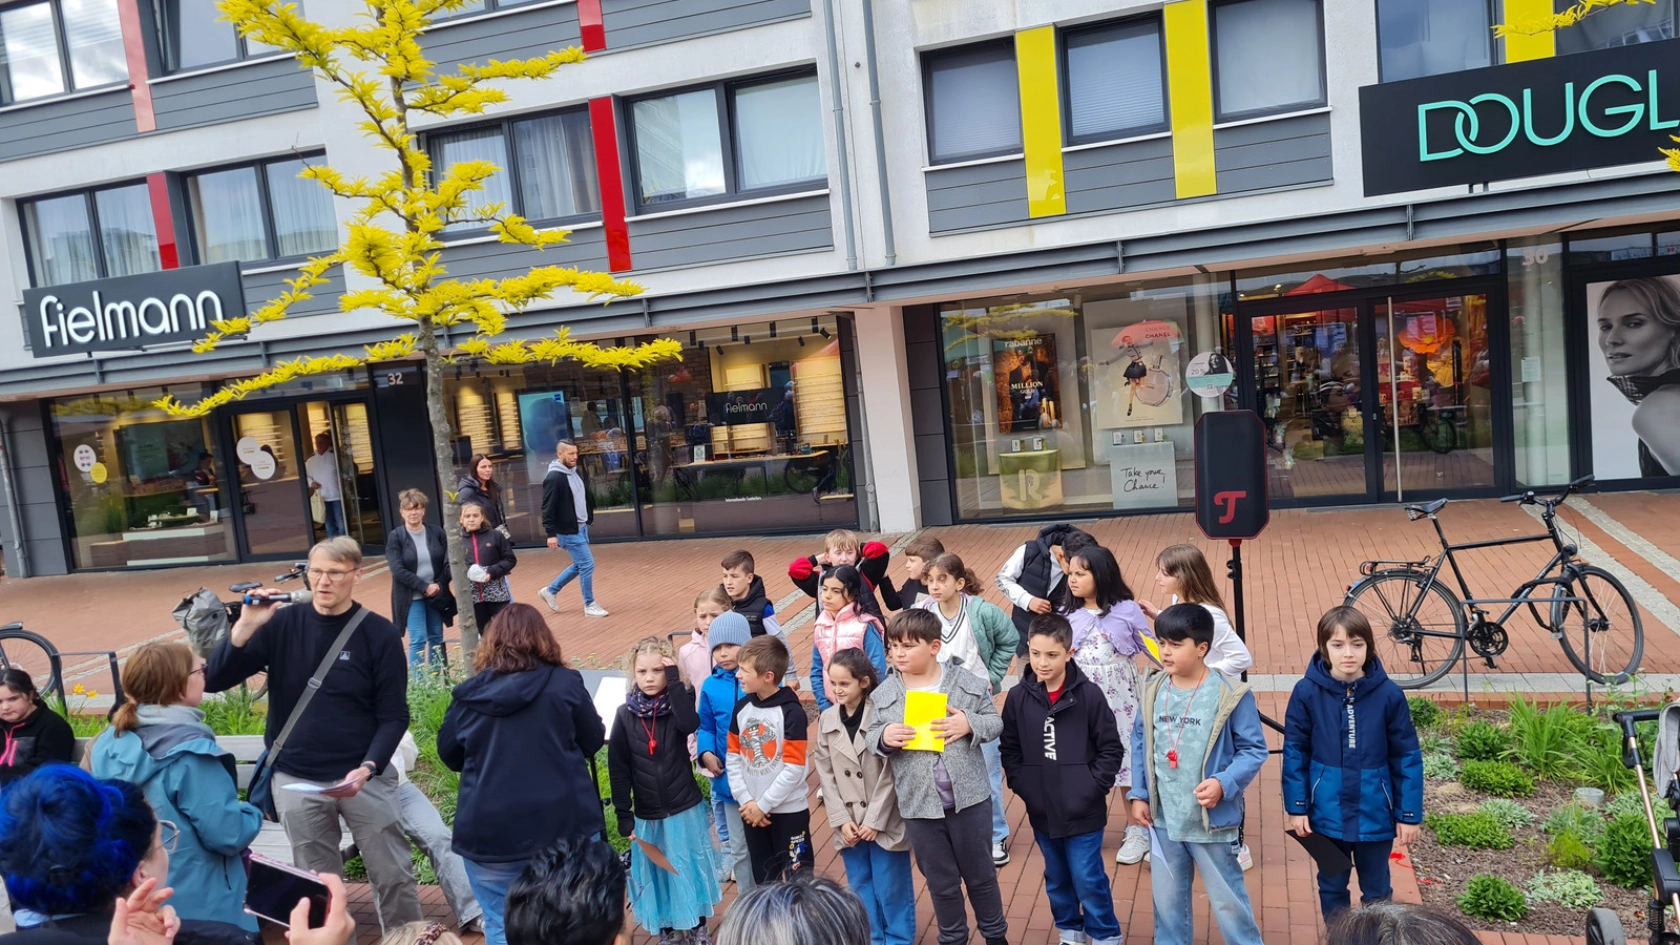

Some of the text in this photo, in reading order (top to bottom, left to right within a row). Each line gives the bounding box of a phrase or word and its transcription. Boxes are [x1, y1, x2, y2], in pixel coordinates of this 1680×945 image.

[1418, 69, 1680, 162] DOUGL
[1522, 248, 1548, 266] 30
[40, 290, 223, 347] fielmann
[1004, 338, 1043, 348] rabanne
[388, 372, 404, 385] 32
[1010, 380, 1044, 389] MILLION
[725, 402, 768, 413] fielmann
[1120, 467, 1142, 478] Take
[1158, 715, 1178, 723] NEW
[1179, 716, 1201, 726] YORK
[1347, 704, 1356, 748] ADVENTURE
[1043, 716, 1057, 761] ACTIVE
